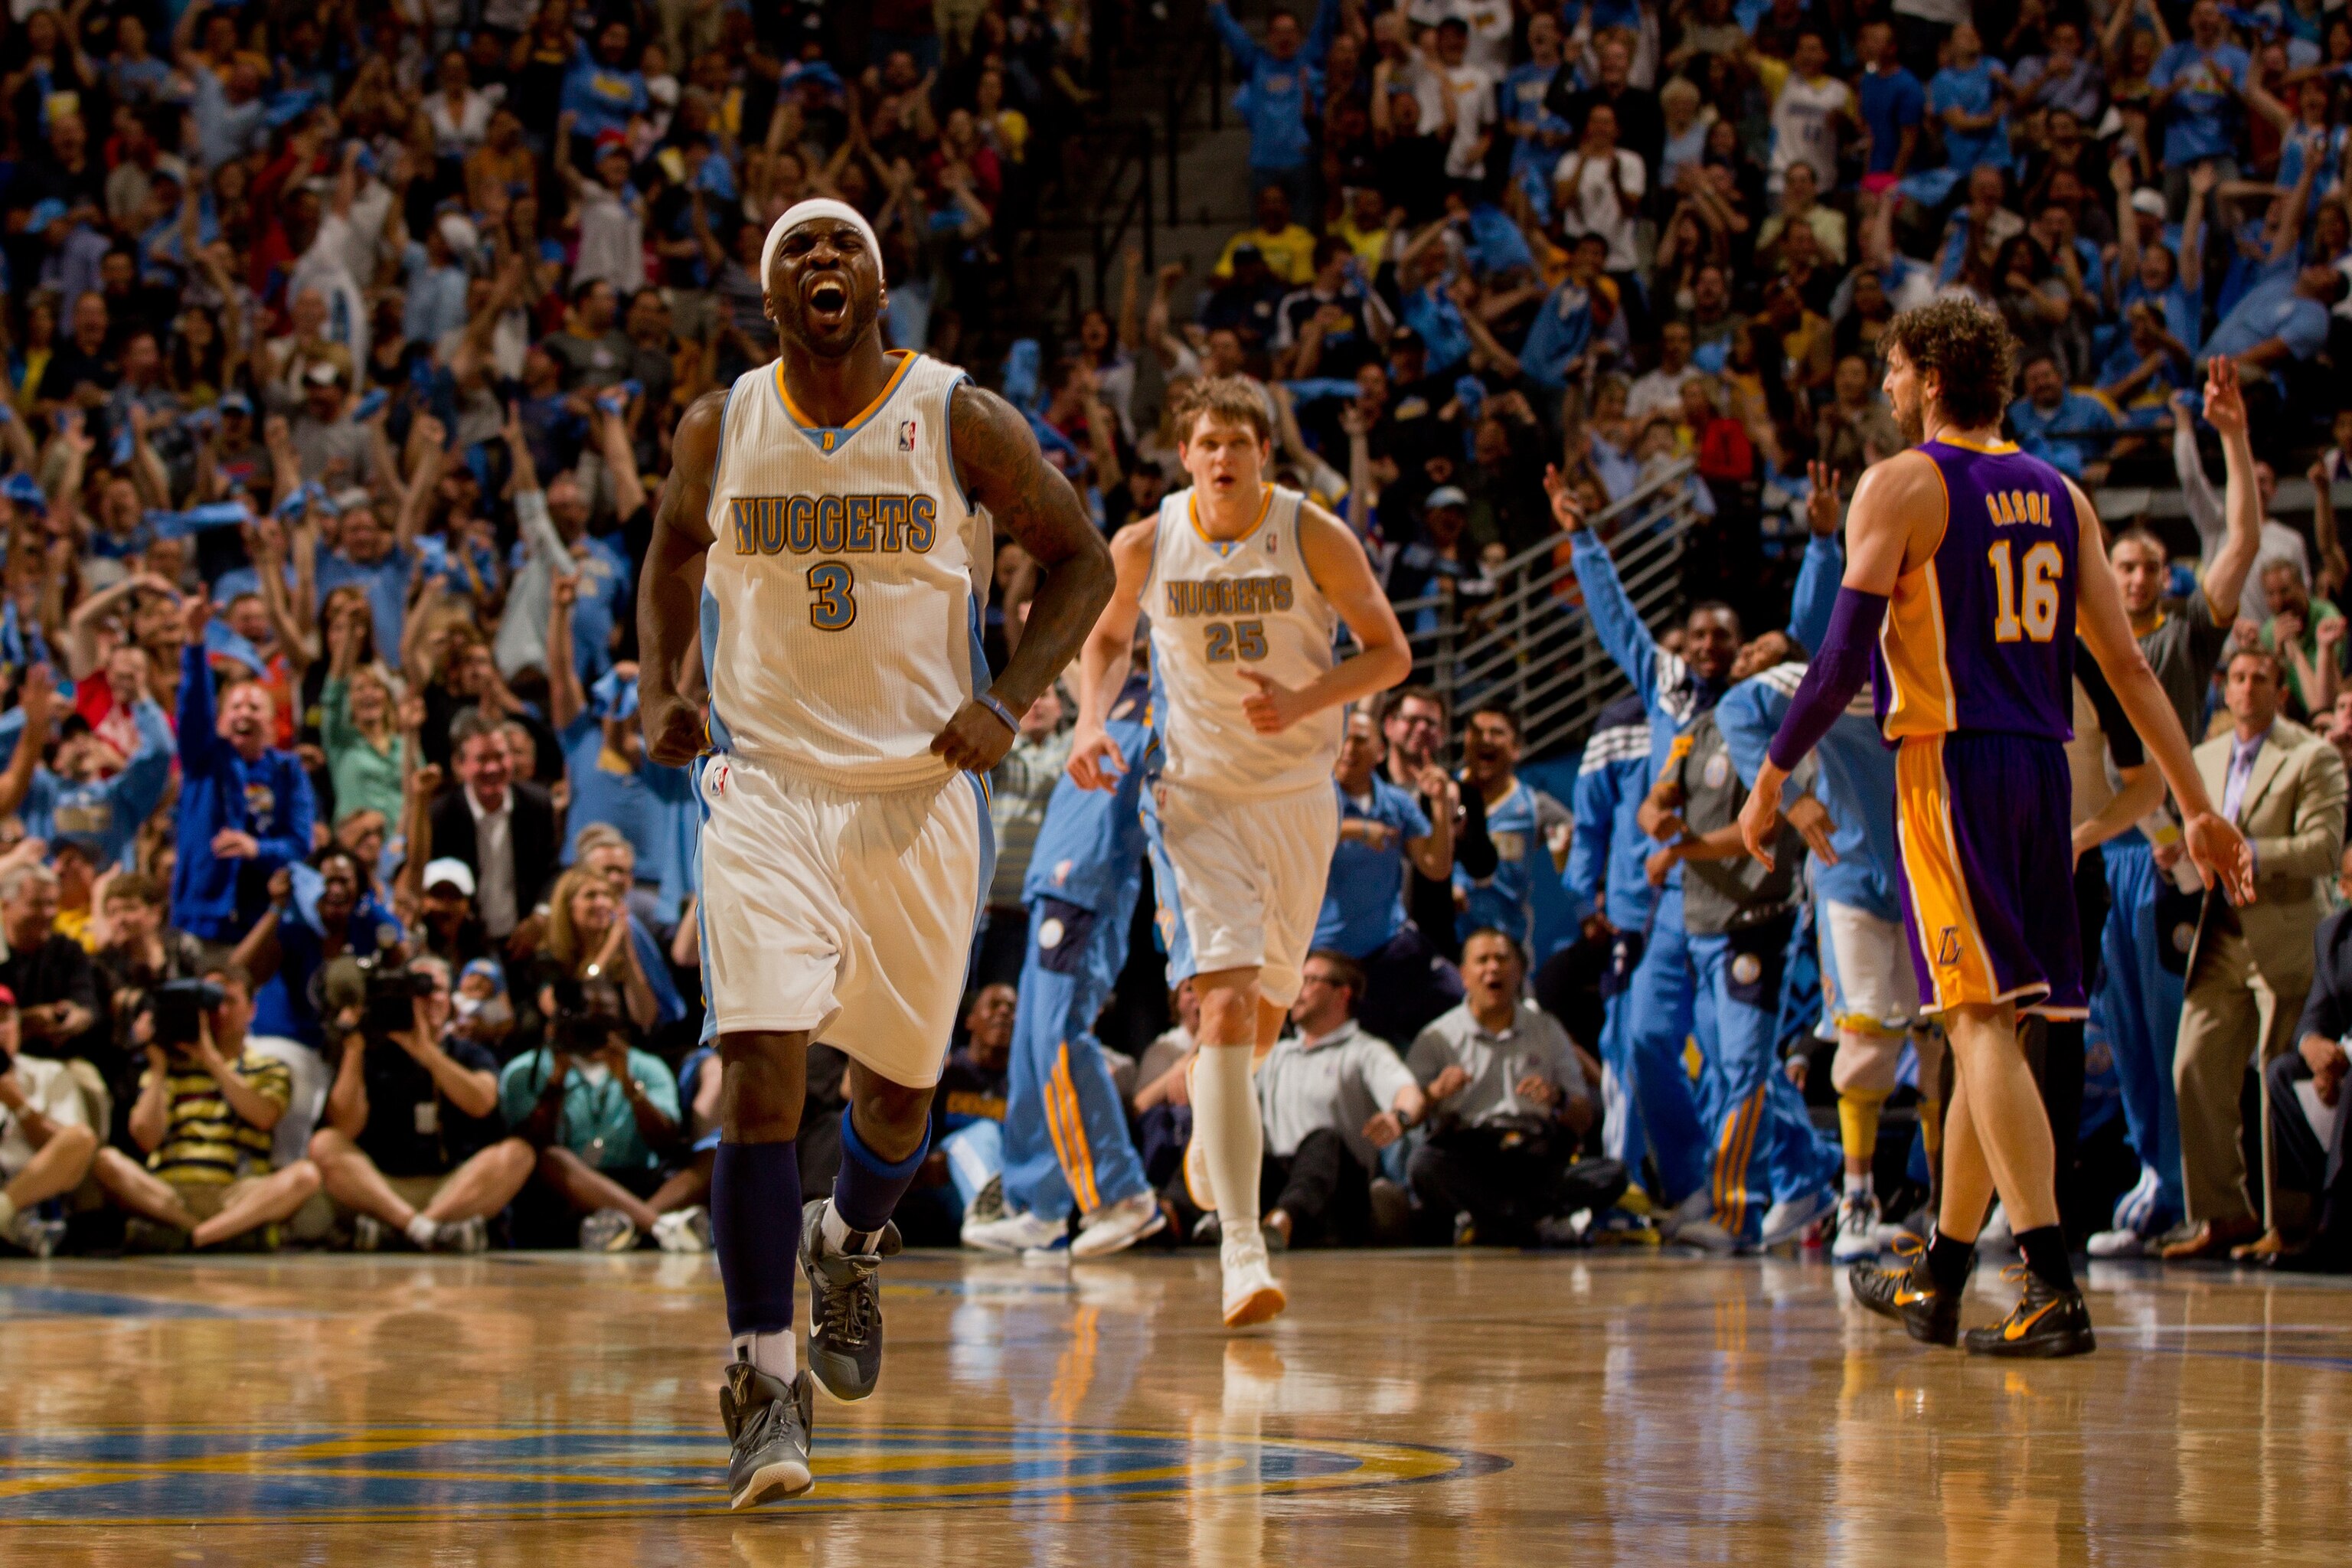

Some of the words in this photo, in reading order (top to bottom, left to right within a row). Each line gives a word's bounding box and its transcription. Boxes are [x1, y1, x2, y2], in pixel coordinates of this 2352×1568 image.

[730, 495, 936, 554] NUGGETS
[1985, 489, 2052, 527] GASOL
[808, 561, 856, 631] 3
[1165, 576, 1294, 617] NUGGETS
[1988, 540, 2063, 642] 16
[1204, 620, 1269, 664] 25
